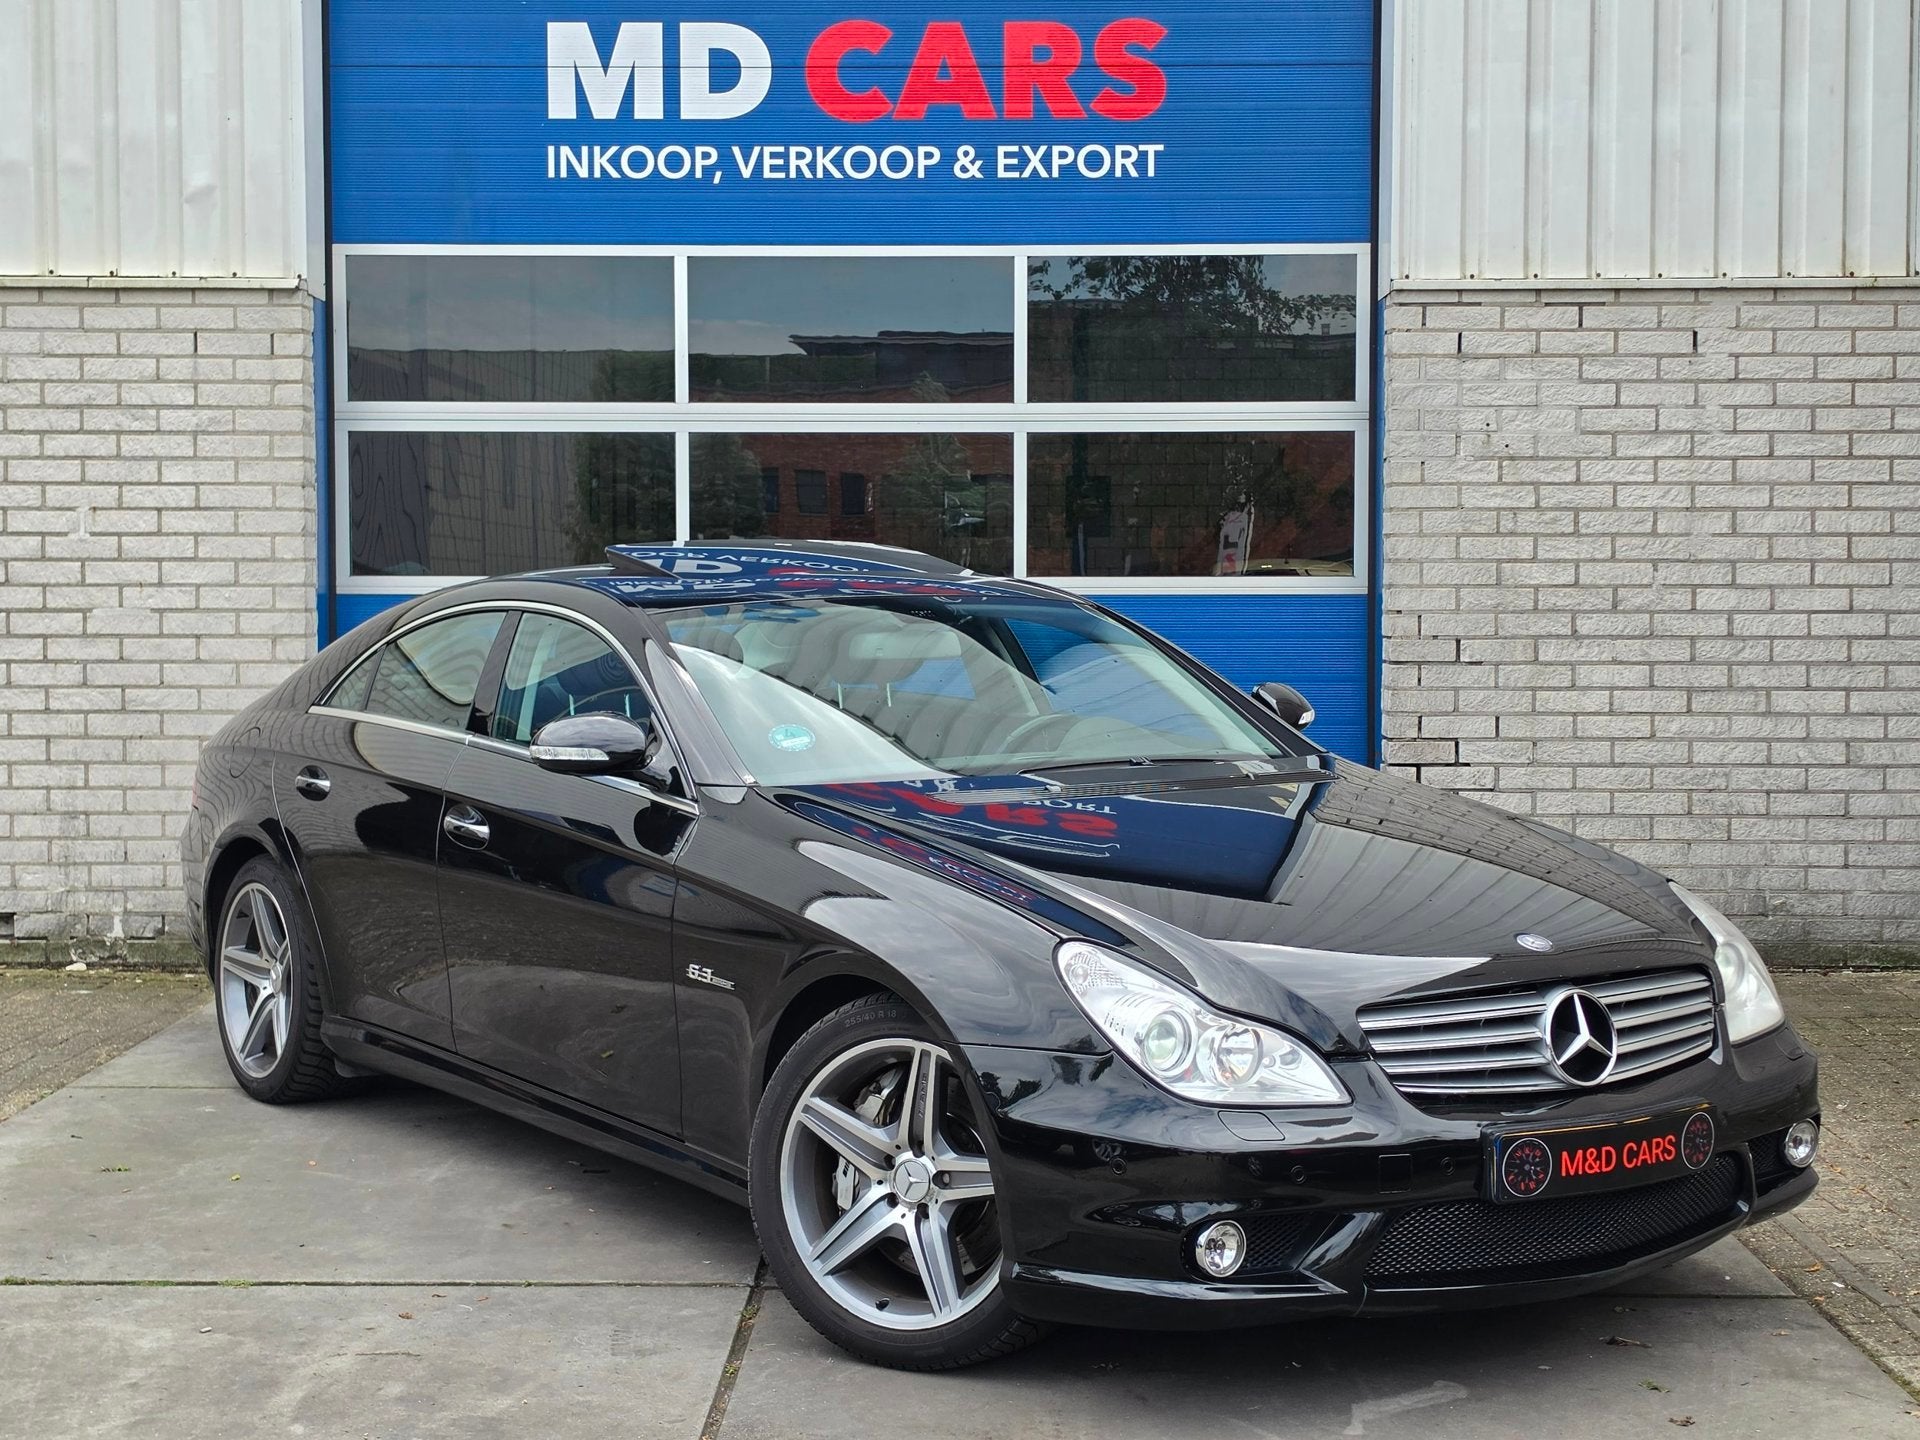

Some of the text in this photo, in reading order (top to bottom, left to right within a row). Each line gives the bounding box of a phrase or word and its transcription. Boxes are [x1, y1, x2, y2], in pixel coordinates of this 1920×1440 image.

[547, 18, 1168, 121] MD CARS
[548, 144, 1164, 184] INKOOP, VERKOOP & EXPORT
[1561, 1146, 1617, 1177] M&D
[1622, 1135, 1676, 1169] CARS
